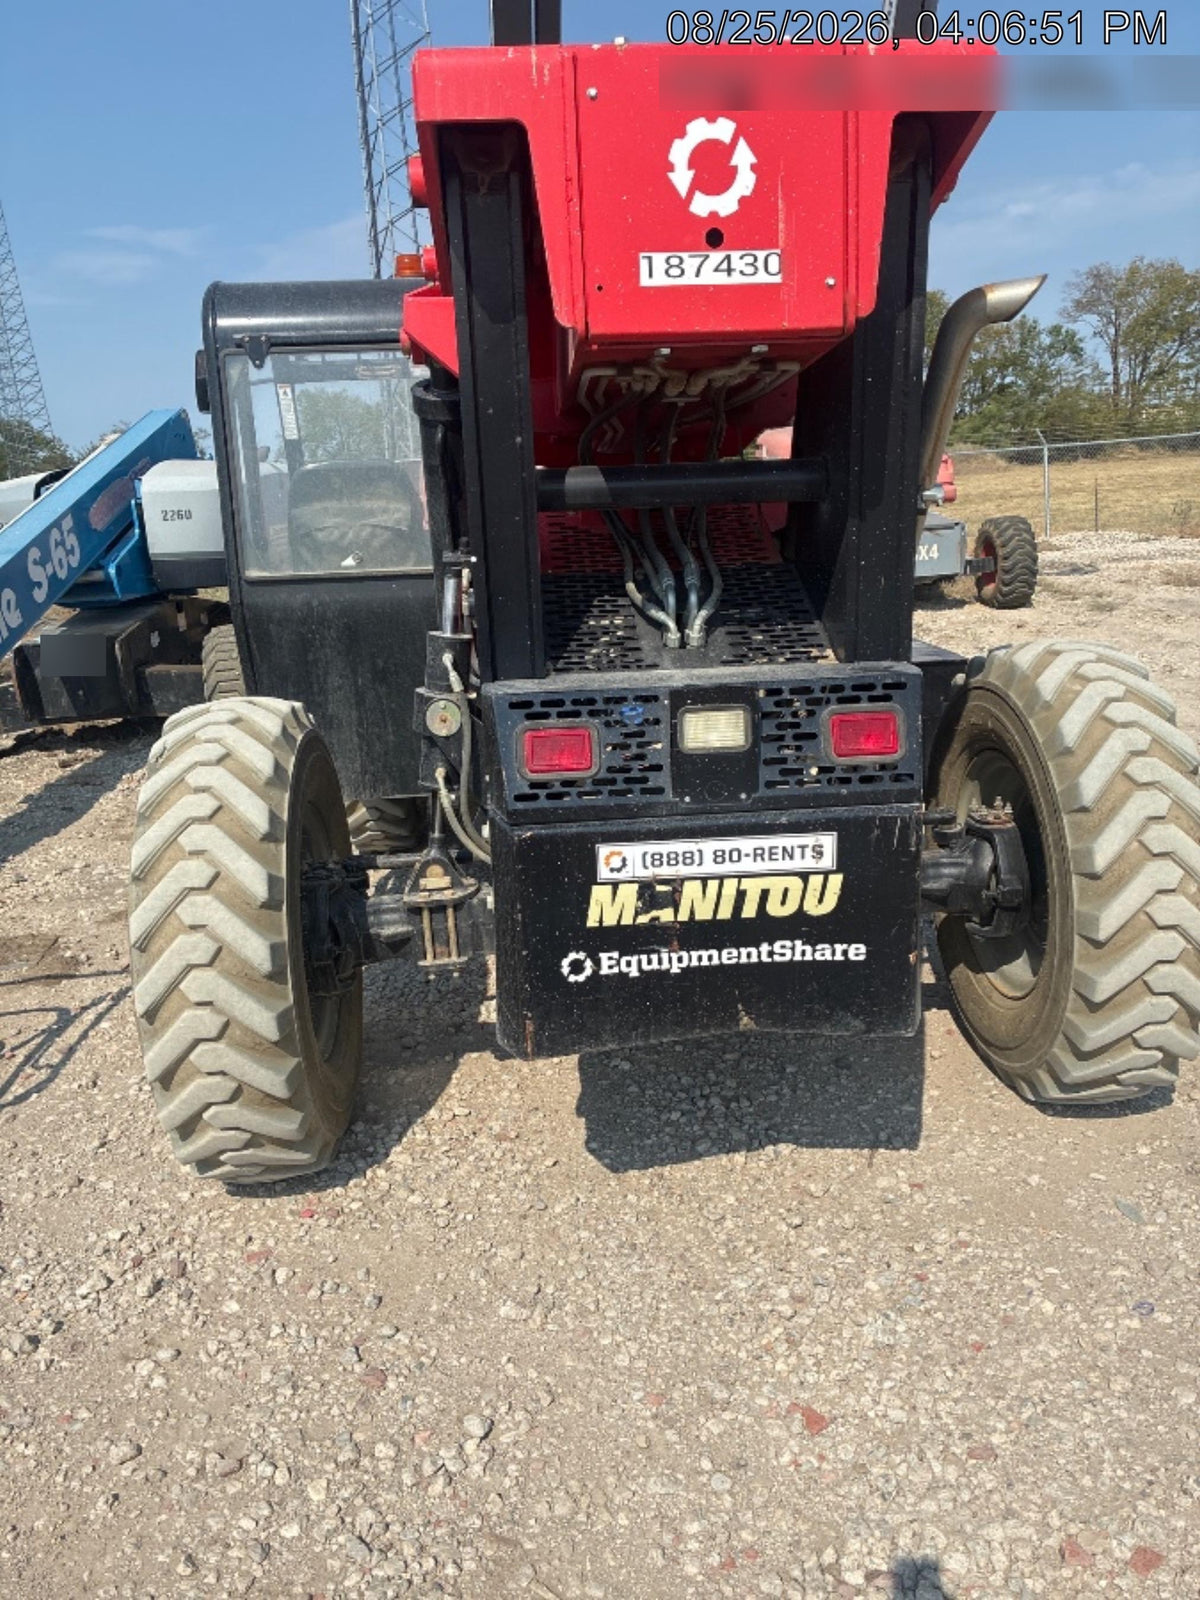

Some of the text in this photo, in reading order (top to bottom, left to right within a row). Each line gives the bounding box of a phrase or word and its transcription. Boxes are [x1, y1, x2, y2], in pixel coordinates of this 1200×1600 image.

[641, 252, 781, 279] 187430
[27, 513, 80, 603] S-65
[916, 544, 939, 560] X4
[642, 843, 825, 869] (888) 80-RENTS
[598, 939, 867, 978] EquipmentShare
